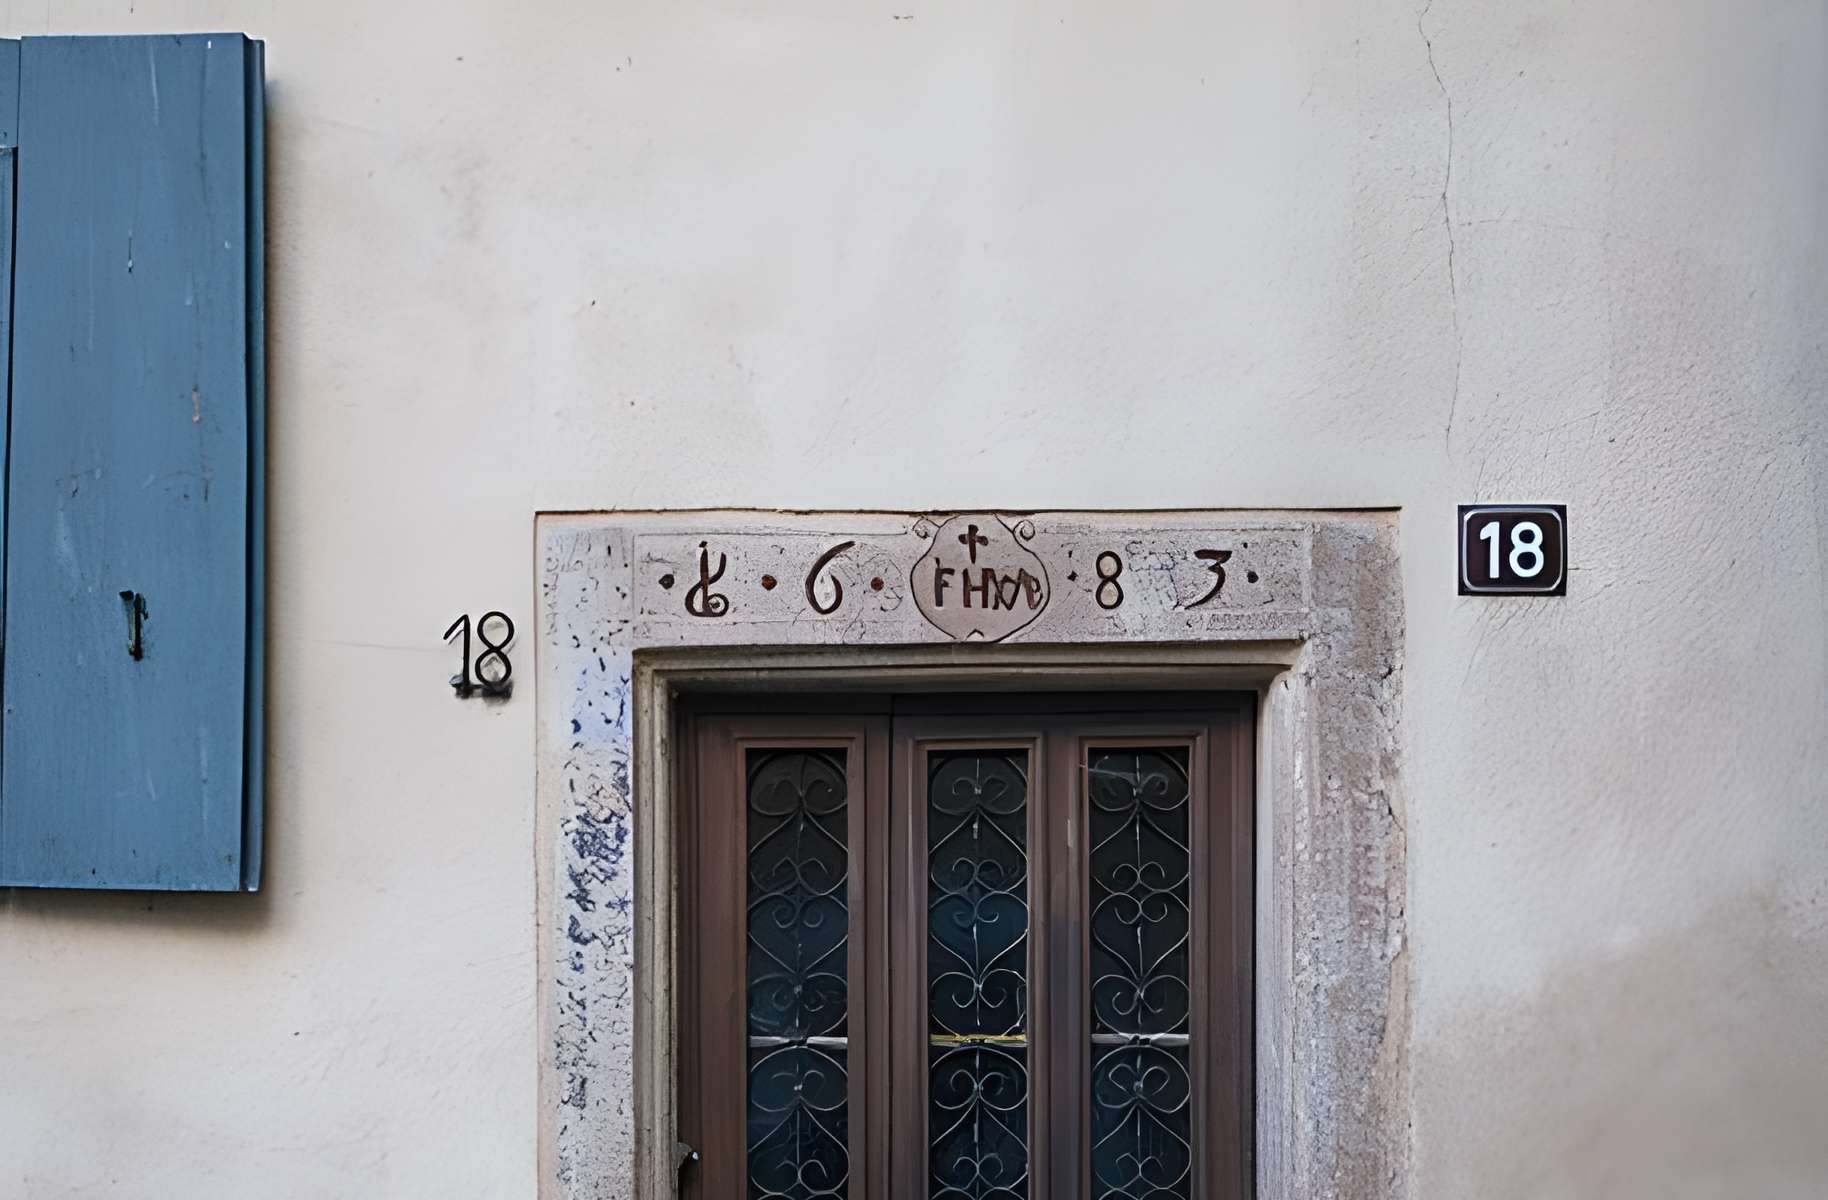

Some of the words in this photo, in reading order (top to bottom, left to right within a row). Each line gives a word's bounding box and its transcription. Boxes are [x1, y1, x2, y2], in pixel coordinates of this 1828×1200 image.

[1095, 550, 1124, 610] 8
[1479, 521, 1545, 579] 18
[443, 611, 515, 688] 18
